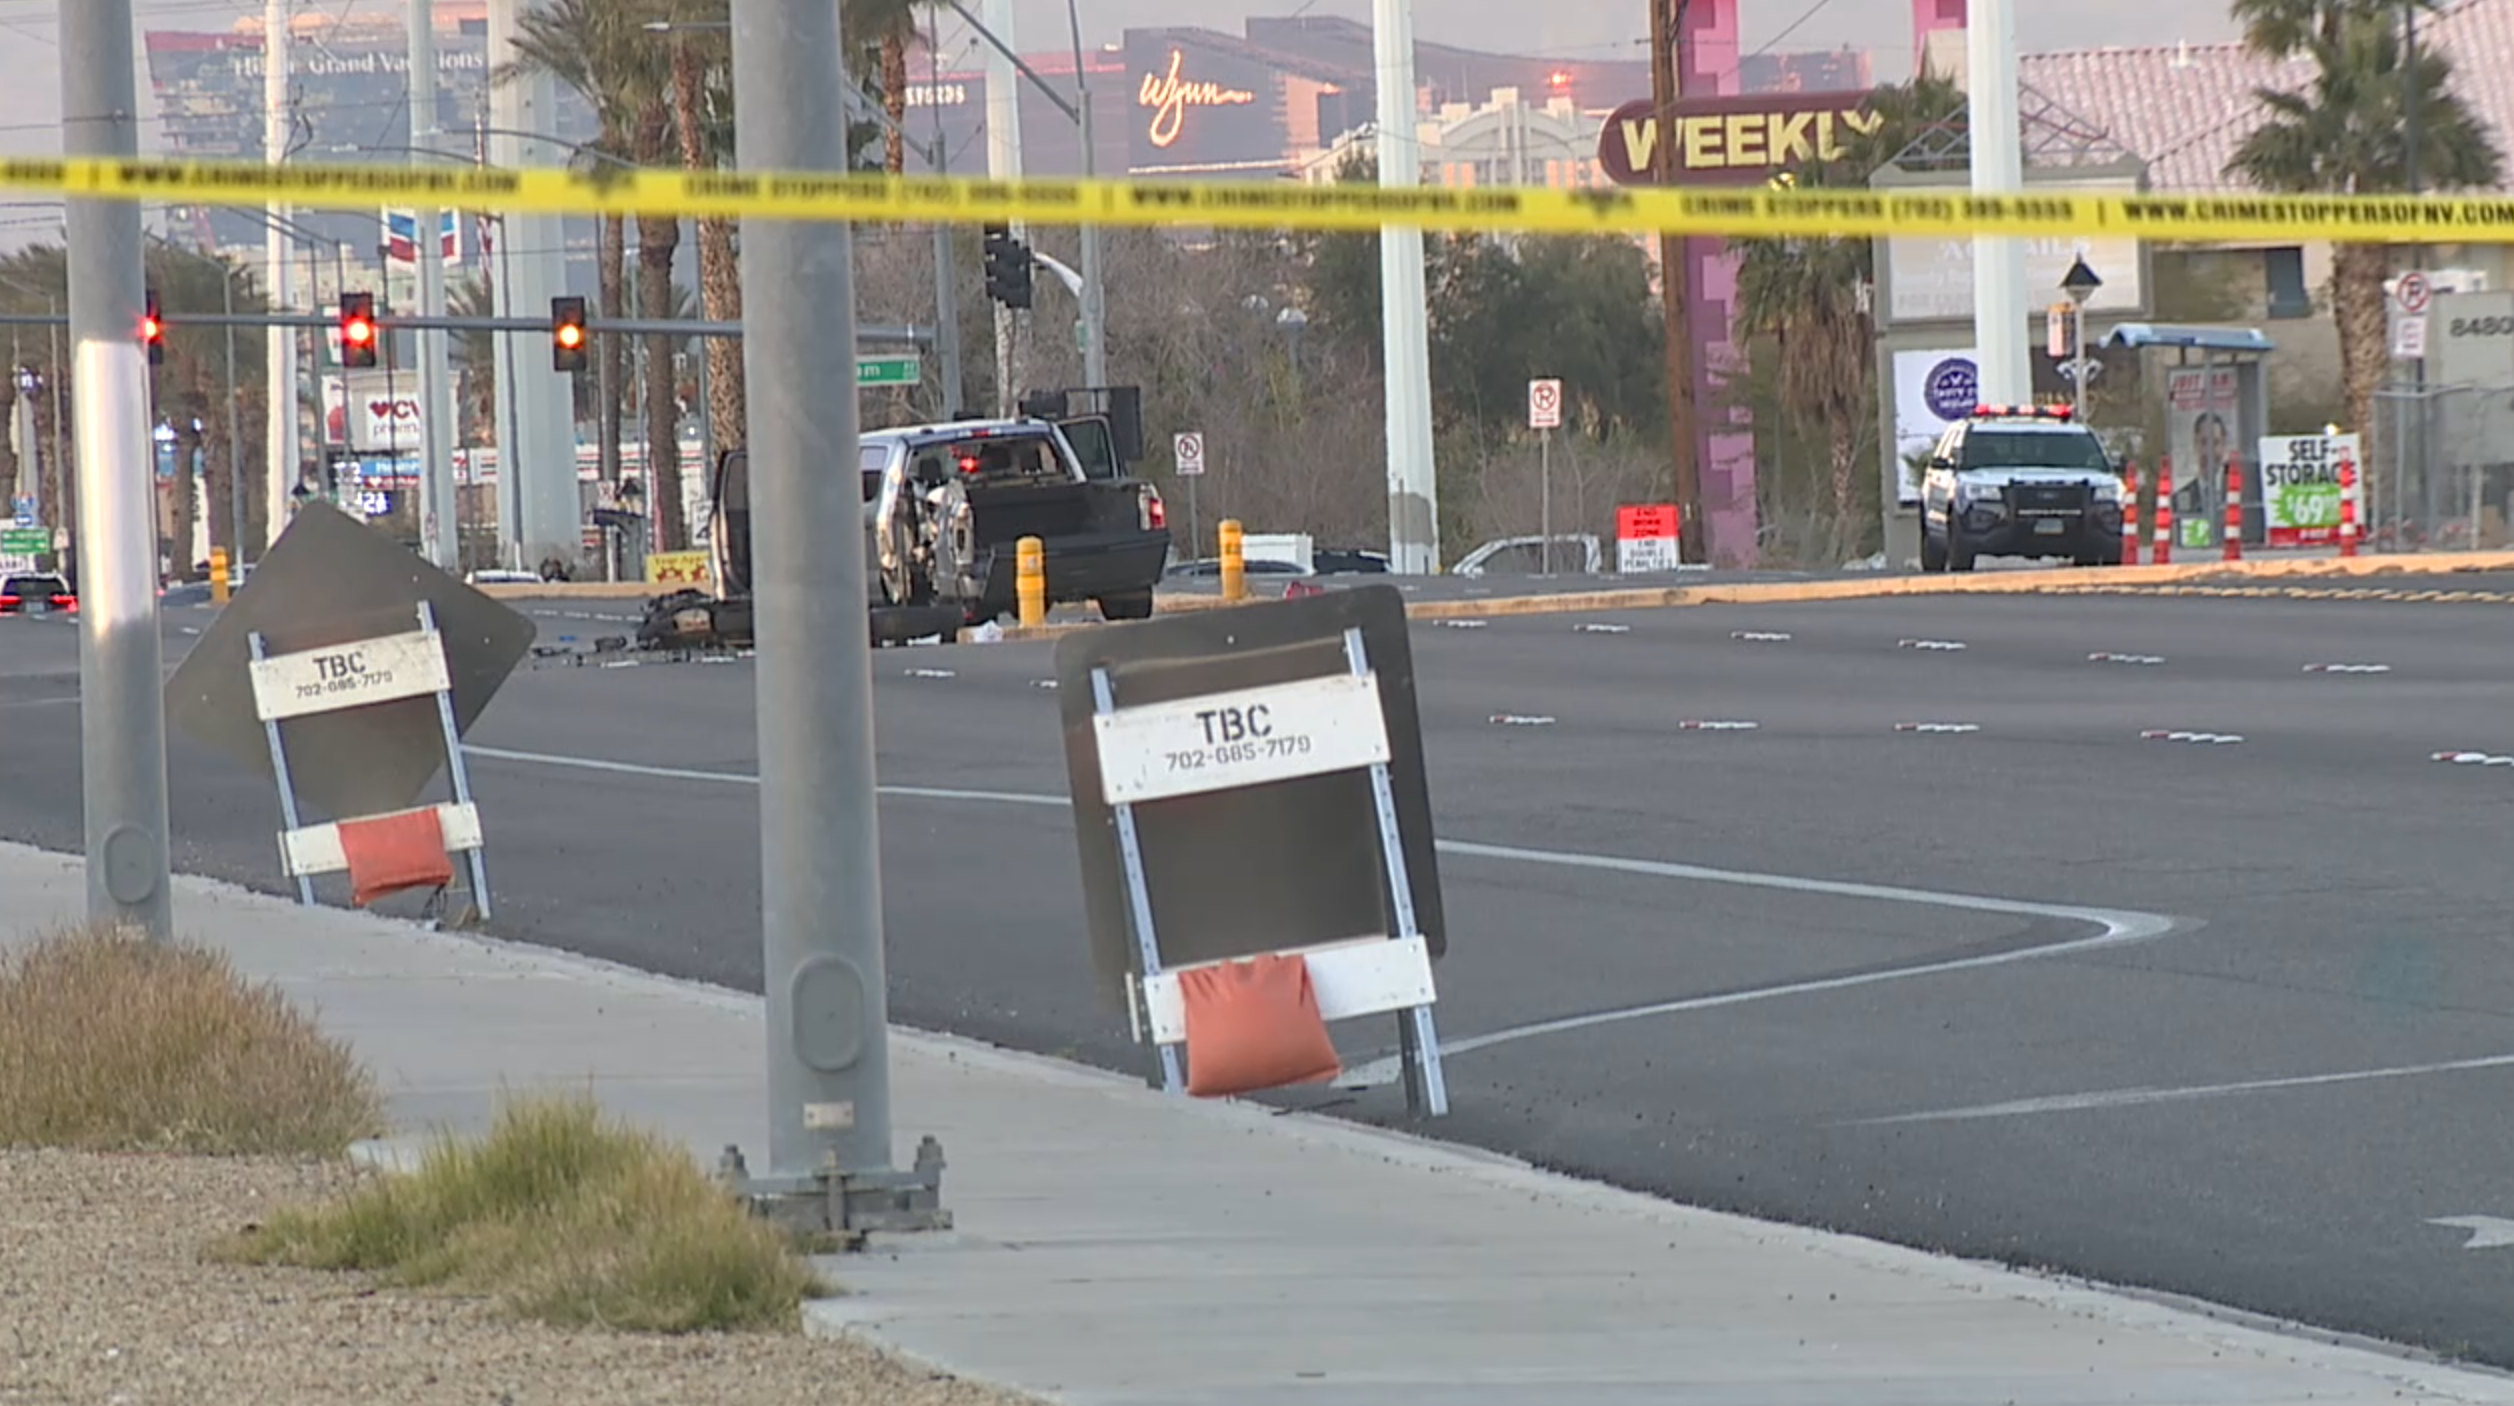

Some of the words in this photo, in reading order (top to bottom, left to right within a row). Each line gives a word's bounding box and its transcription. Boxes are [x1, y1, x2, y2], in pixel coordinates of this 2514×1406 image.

[308, 52, 374, 75] Grand
[2123, 199, 2514, 226] WWW.CRIMESTOPPERSOFNV.COM
[2289, 439, 2338, 462] SELF-
[312, 651, 367, 681] TBC
[1195, 704, 1273, 745] TBC
[1165, 734, 1312, 772] 702-685-7179
